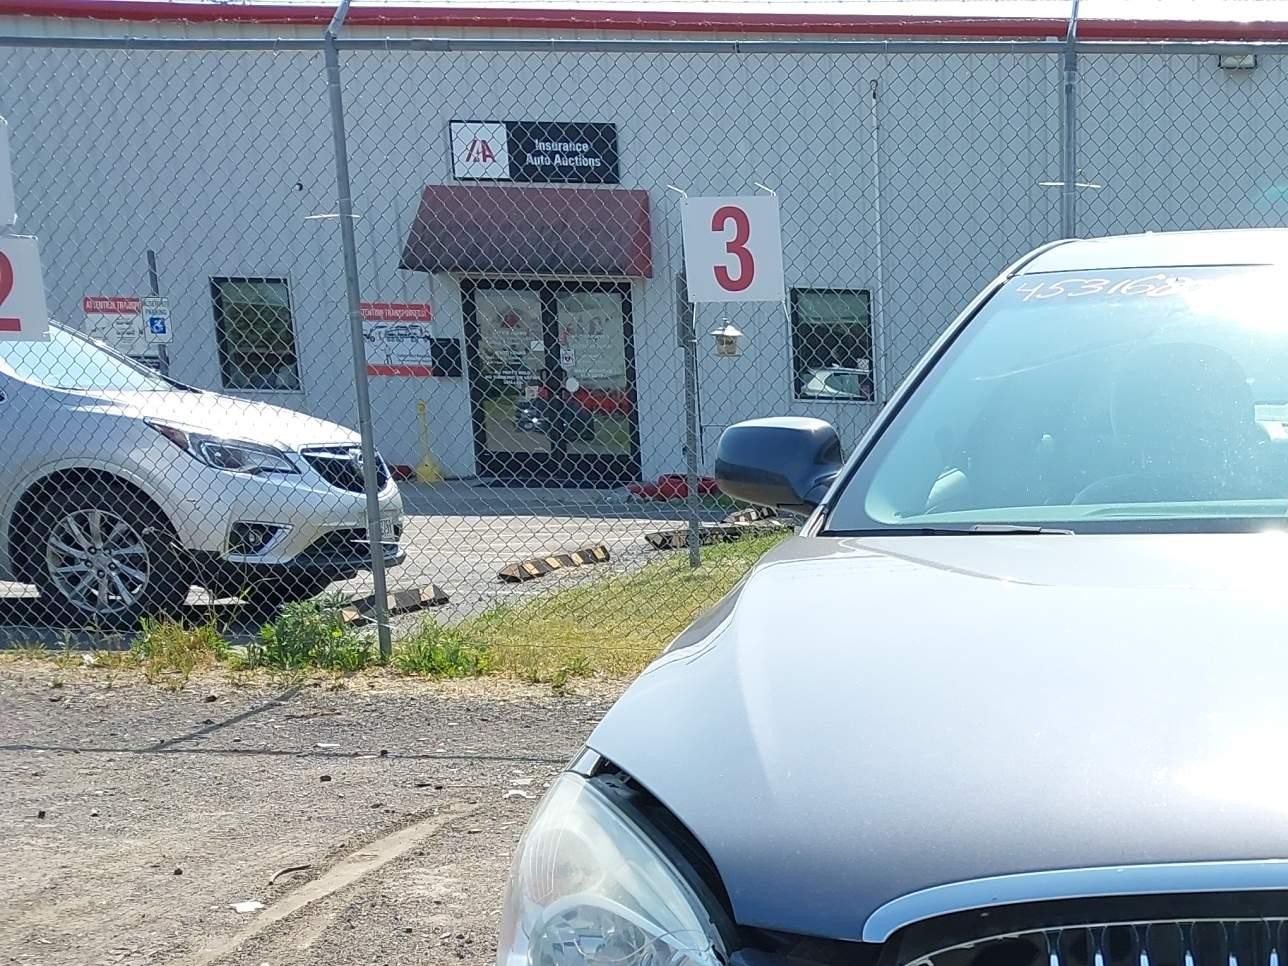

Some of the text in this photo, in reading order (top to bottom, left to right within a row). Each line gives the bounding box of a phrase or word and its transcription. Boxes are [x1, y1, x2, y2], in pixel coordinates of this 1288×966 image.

[535, 139, 589, 152] Insurance
[526, 153, 601, 167] Auto Auctions
[711, 206, 755, 292] 3
[1016, 274, 1194, 301] 453168
